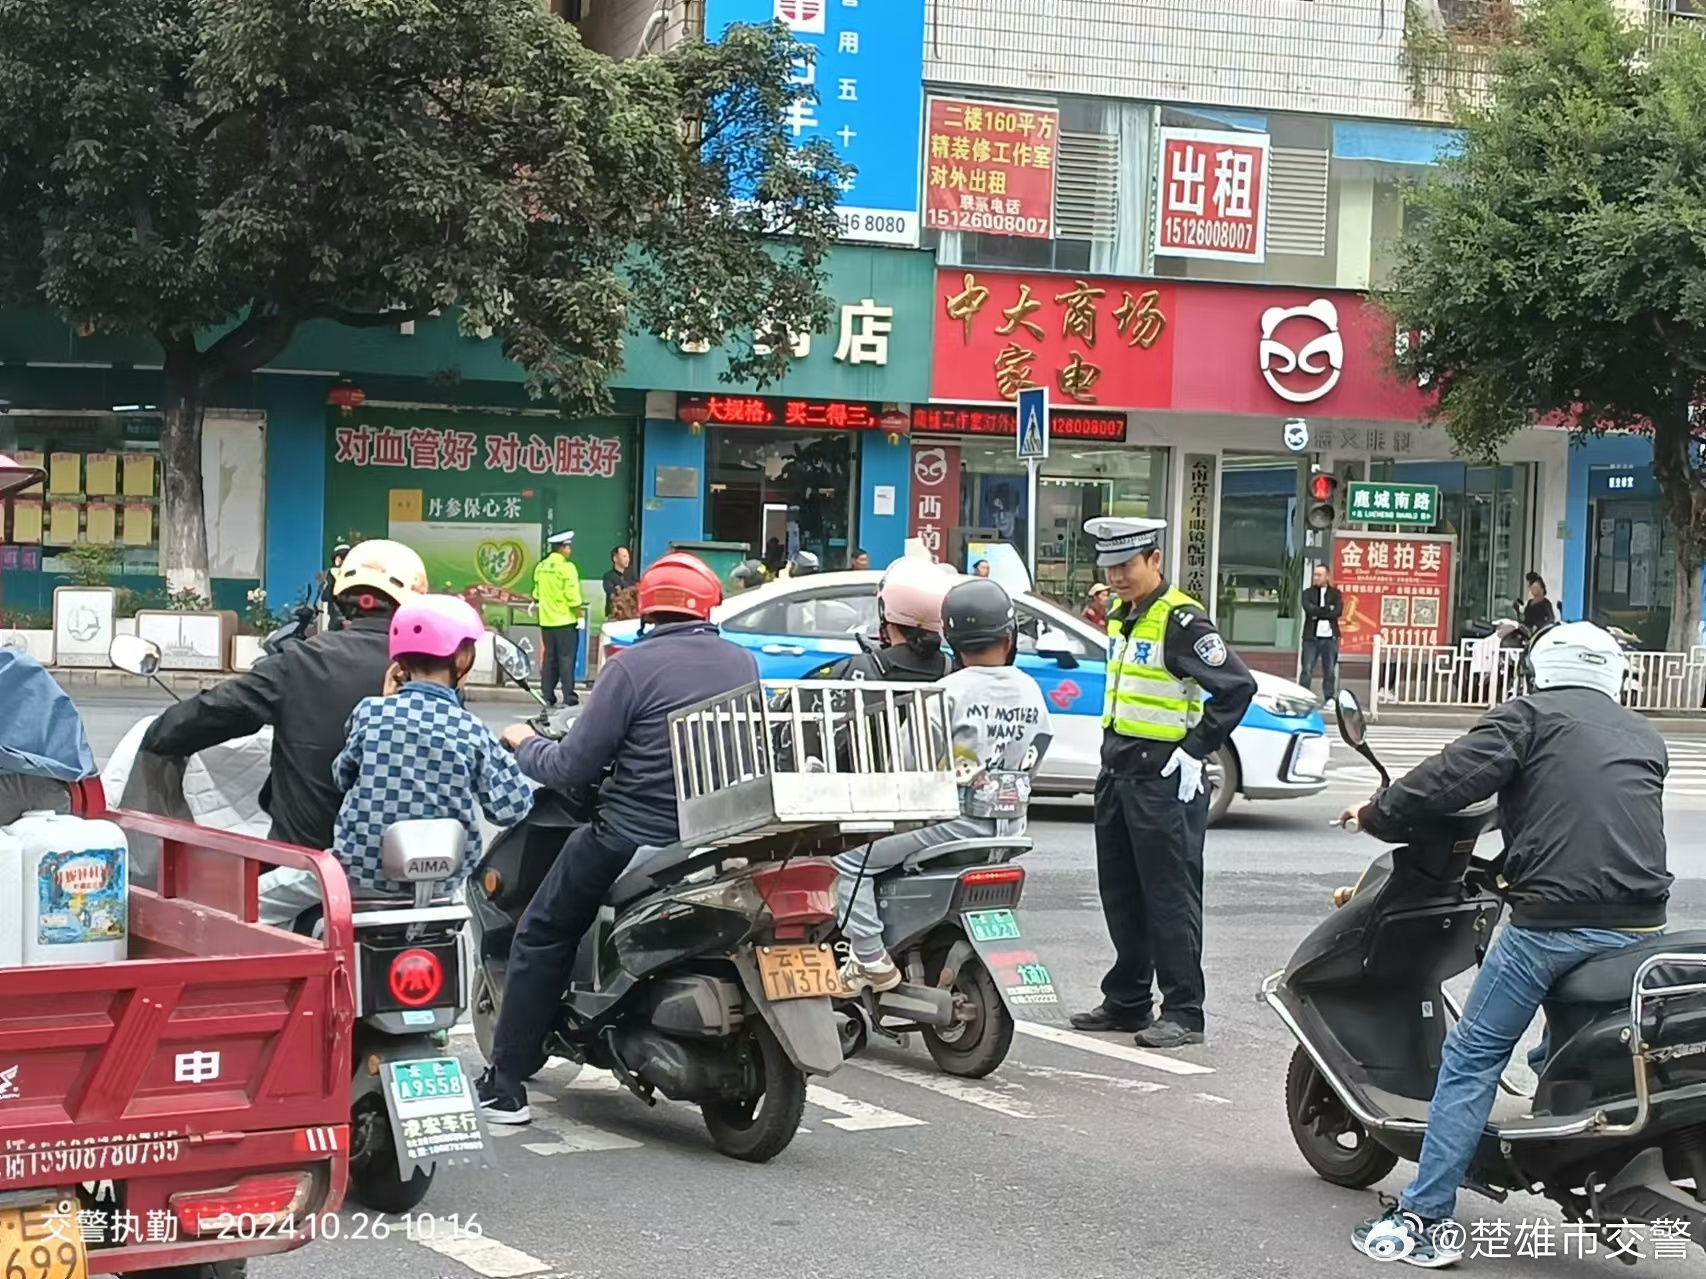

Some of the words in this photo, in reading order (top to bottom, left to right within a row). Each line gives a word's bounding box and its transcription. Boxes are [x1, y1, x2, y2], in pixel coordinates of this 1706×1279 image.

[943, 106, 1055, 140] 二楼160平方
[931, 133, 1052, 169] 精装修工作室
[929, 165, 1007, 195] 对外出租
[1168, 145, 1254, 218] 出租
[959, 195, 1021, 216] 联系电话
[864, 215, 906, 234] 8080
[928, 208, 1048, 235] 15126008007
[1165, 218, 1253, 250] 15126008007
[945, 273, 1168, 349] 中大商场
[994, 342, 1102, 403] 家电
[336, 427, 476, 472] 对血管好
[485, 434, 622, 478] 对心脏好
[428, 497, 522, 518] 丹参保心茶
[1353, 489, 1430, 511] 鹿城南路
[1341, 540, 1441, 571] 金槌拍卖
[966, 704, 989, 720] MY
[995, 706, 1039, 725] MOTHER
[408, 860, 450, 874] AIMA
[175, 1051, 220, 1083] 申
